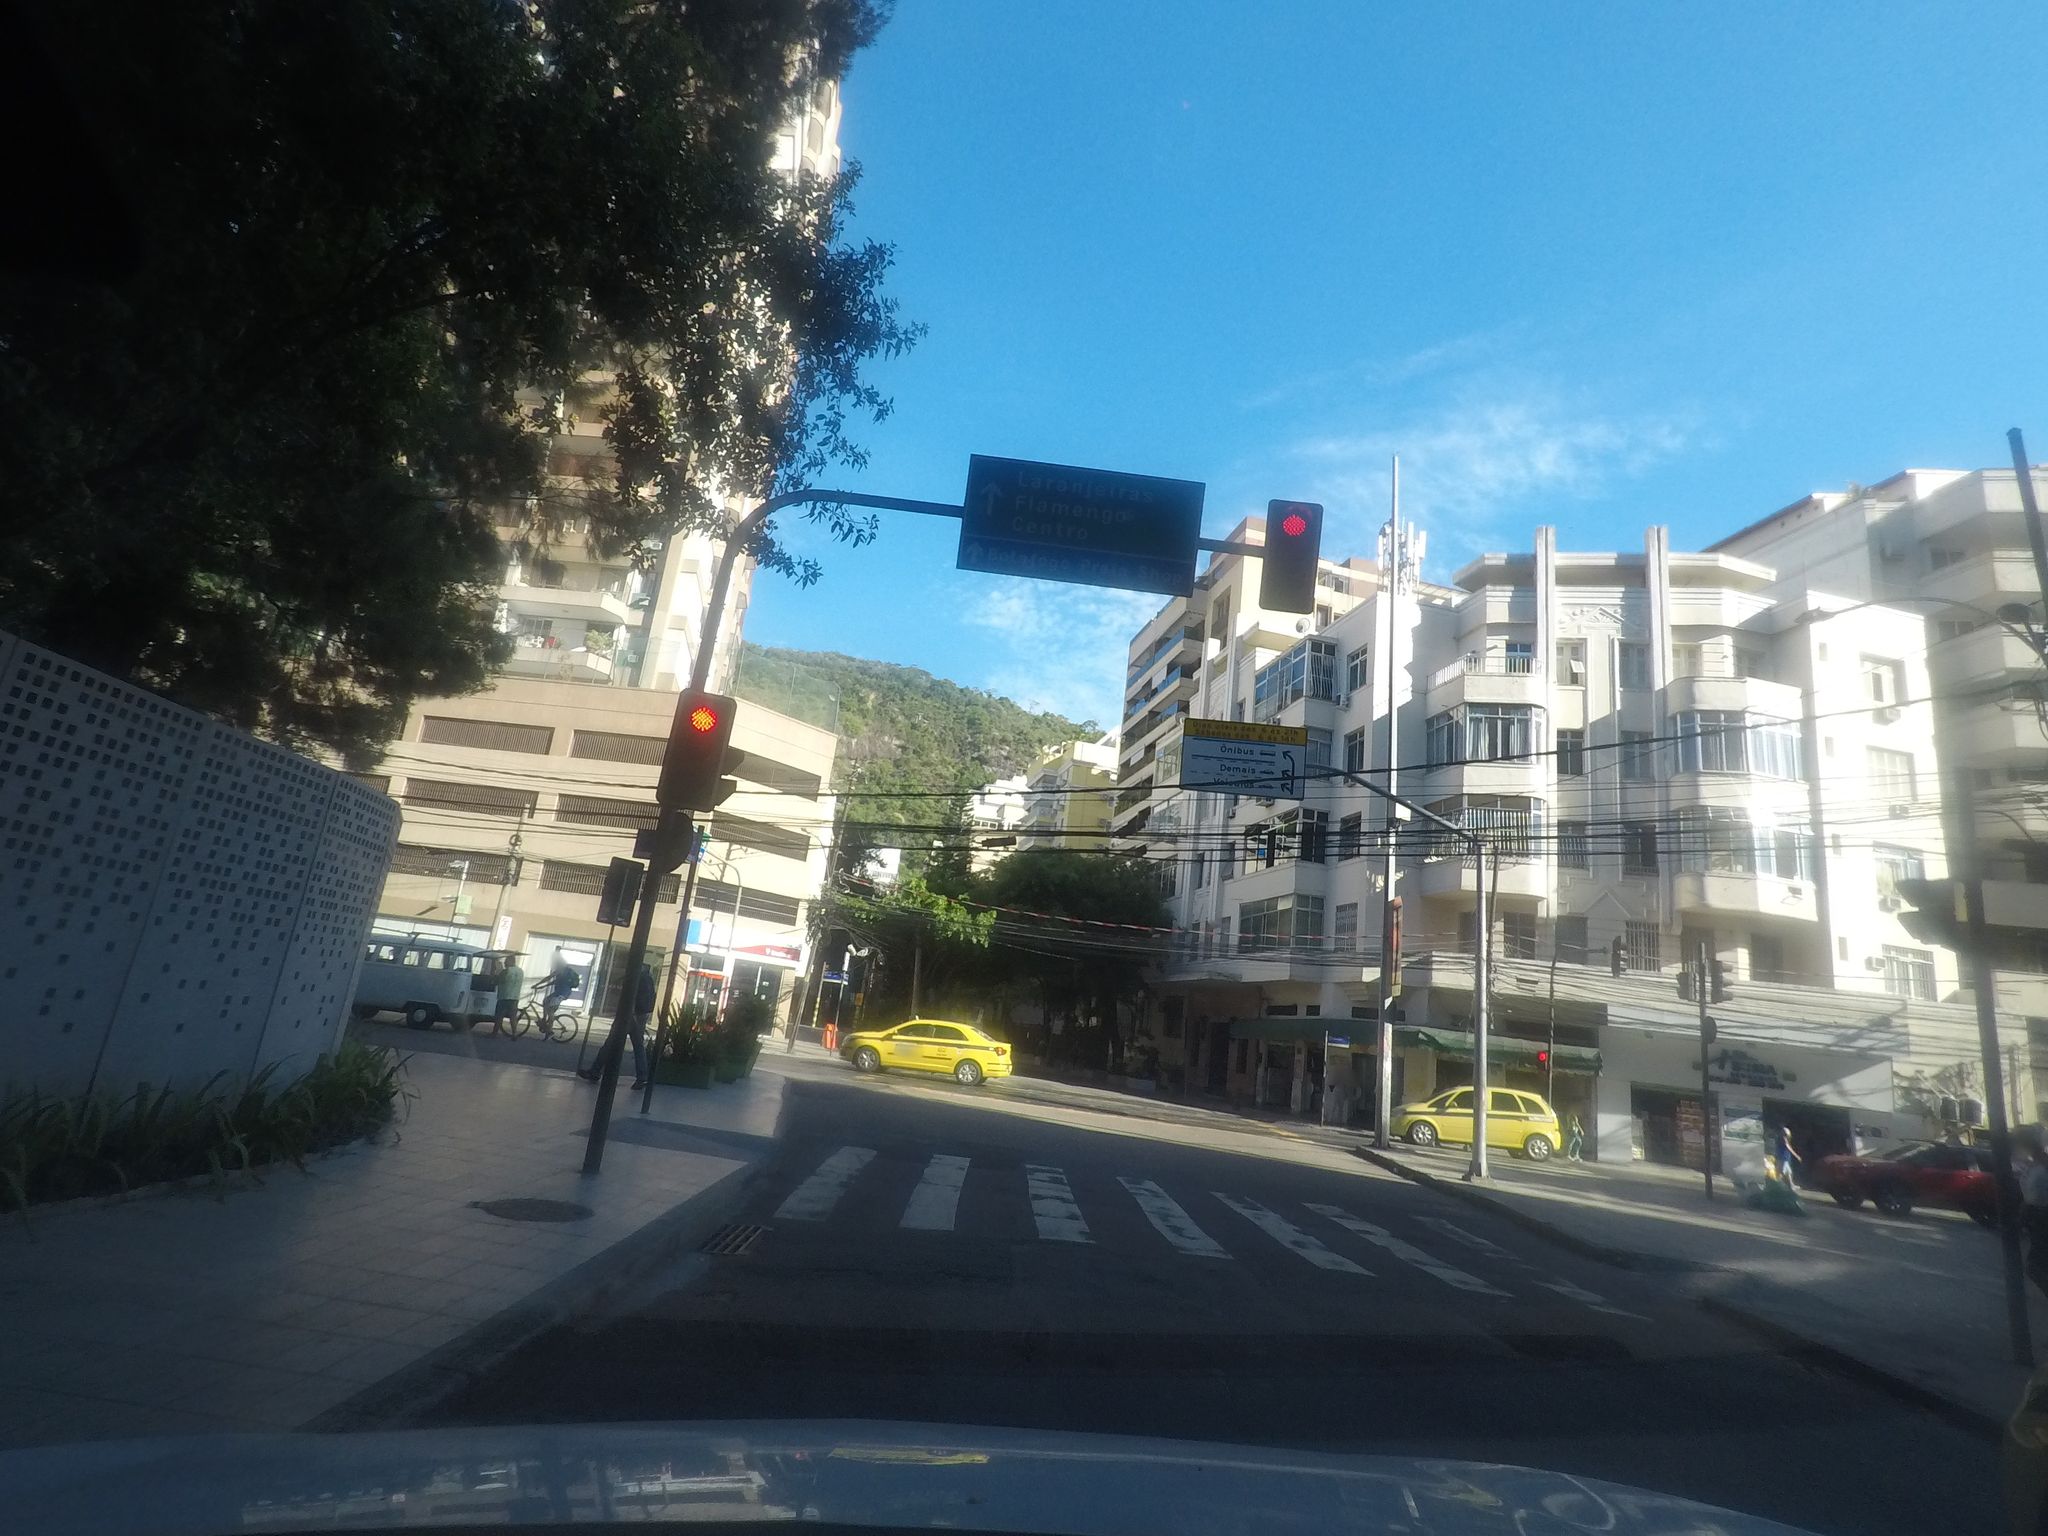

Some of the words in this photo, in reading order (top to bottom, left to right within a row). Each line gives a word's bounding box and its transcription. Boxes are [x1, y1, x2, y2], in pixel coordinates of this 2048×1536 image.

[1017, 471, 1153, 504] Laranjeiras
[1014, 495, 1130, 525] Flamengo
[1011, 517, 1089, 540] Centro
[1139, 565, 1184, 587] Shop
[1220, 744, 1255, 756] Ônibus
[1220, 763, 1256, 774] Demais
